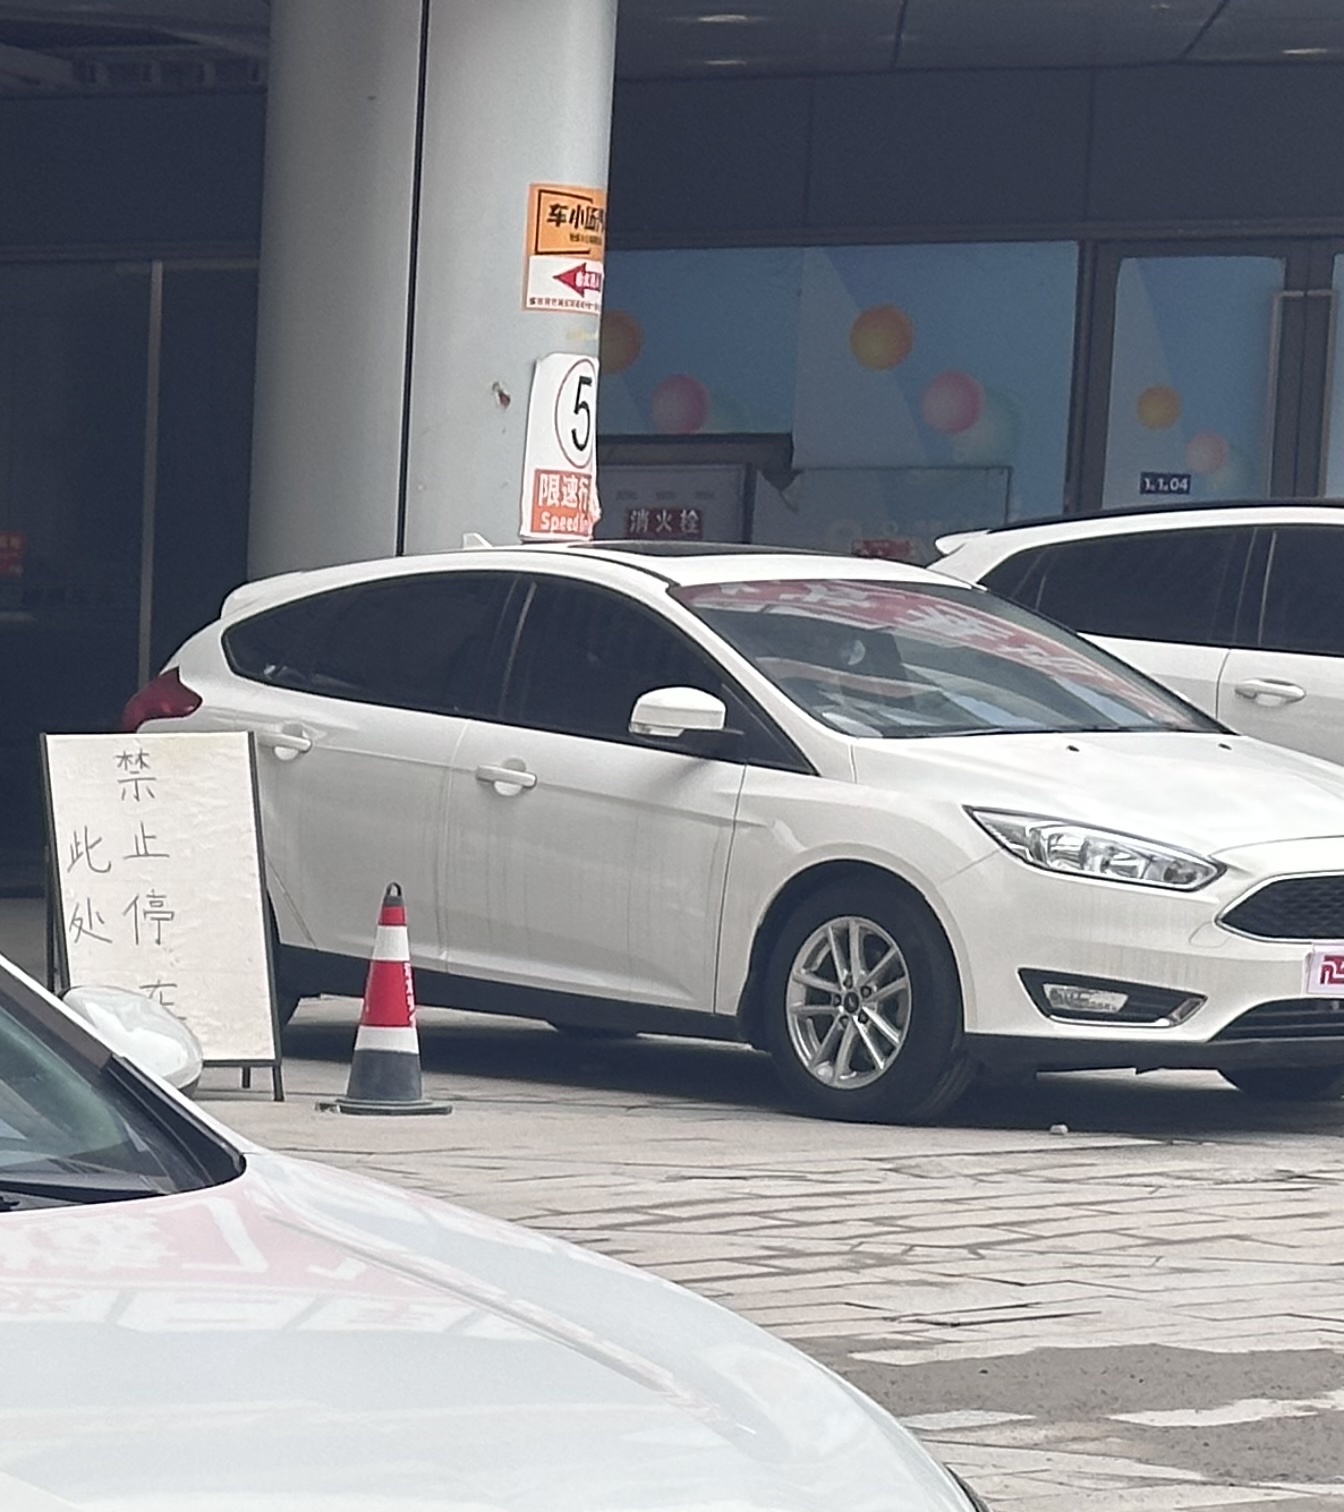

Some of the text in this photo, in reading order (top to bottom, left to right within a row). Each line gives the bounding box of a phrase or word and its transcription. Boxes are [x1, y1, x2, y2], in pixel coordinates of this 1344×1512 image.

[1144, 477, 1189, 491] 1.1.04
[629, 509, 700, 534] 消火栓
[65, 824, 113, 945] 此处
